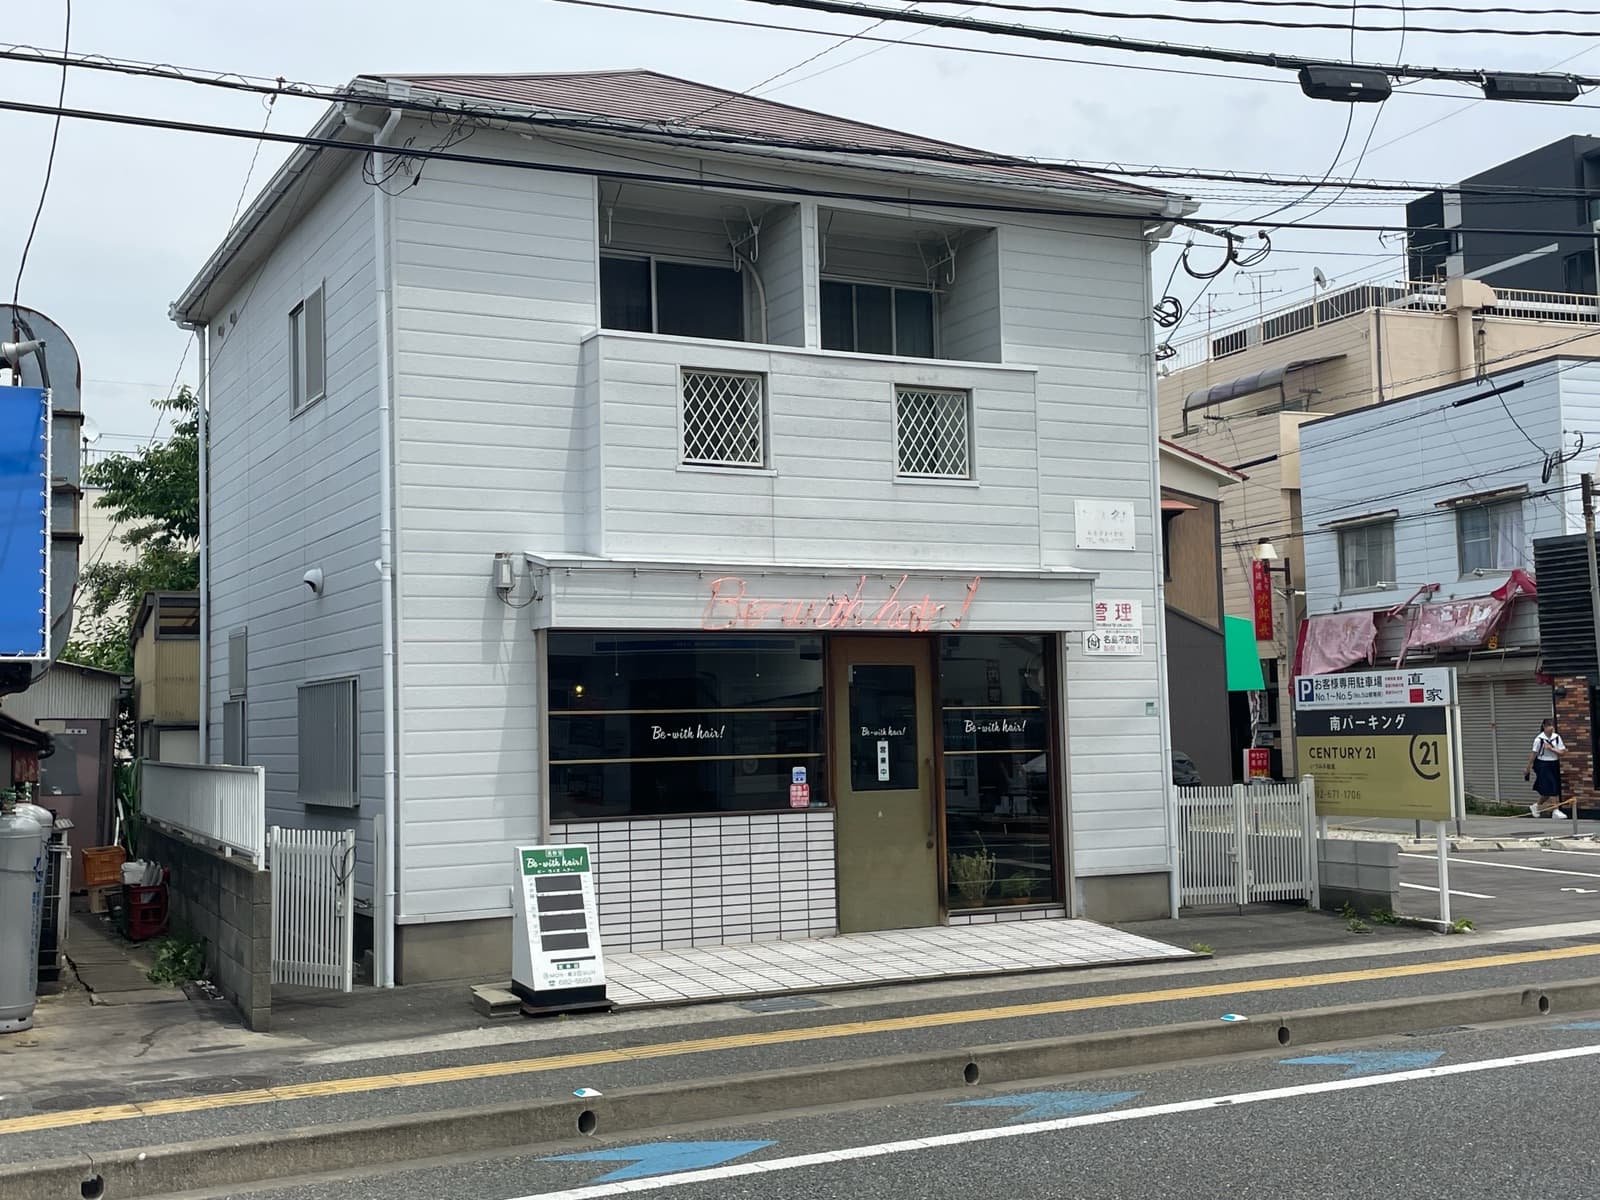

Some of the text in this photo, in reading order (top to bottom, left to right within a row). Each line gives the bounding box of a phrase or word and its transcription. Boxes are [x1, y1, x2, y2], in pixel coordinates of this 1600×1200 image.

[700, 574, 866, 631] Be-with
[1095, 602, 1134, 622] 管理
[1300, 680, 1312, 701] P
[1315, 676, 1383, 690] お客様専用駐車場
[964, 718, 1027, 733] Be-with hair!
[1329, 713, 1406, 731] 南パーキング
[651, 723, 726, 740] Be-with hair!
[1308, 746, 1376, 760] CENTURY 21
[525, 856, 584, 869] Be-with hair!
